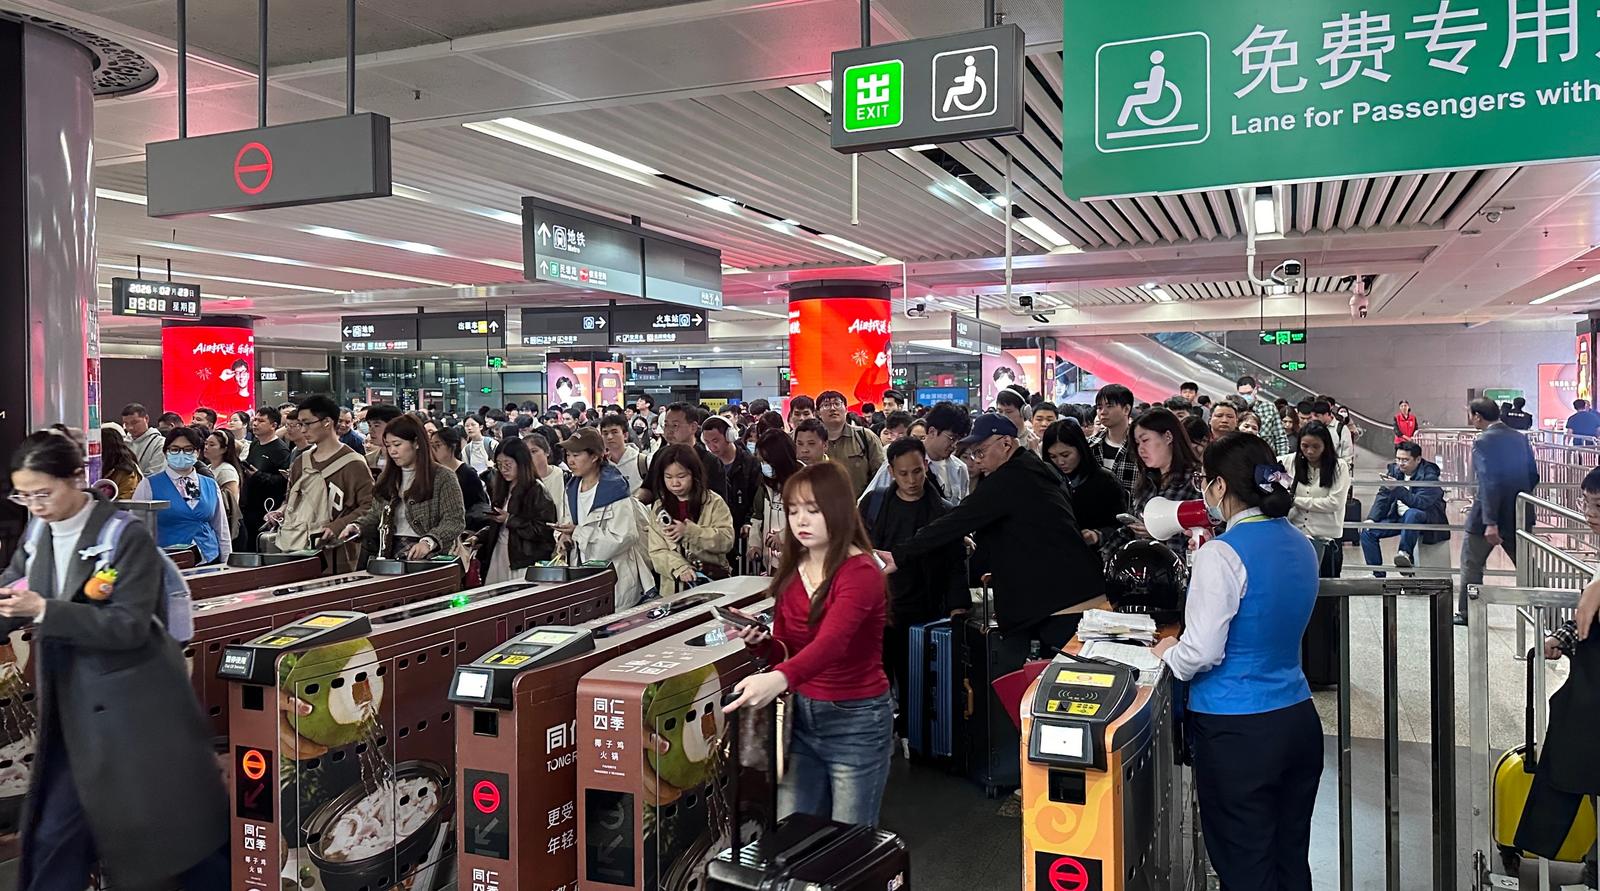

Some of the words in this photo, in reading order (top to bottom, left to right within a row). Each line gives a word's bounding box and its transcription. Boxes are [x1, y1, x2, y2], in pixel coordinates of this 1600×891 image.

[1232, 0, 1600, 98] 免费专用
[857, 73, 890, 106] 出
[856, 104, 889, 121] EXIT
[1231, 112, 1296, 135] Lane
[1303, 106, 1343, 128] for
[1352, 87, 1526, 123] Passengers
[1536, 79, 1600, 106] with
[567, 229, 586, 247] 地铁
[656, 314, 679, 323] 火车站
[329, 481, 345, 520] P
[594, 698, 625, 715] 同仁
[594, 715, 625, 732] 四季
[600, 751, 620, 762] 火锅
[547, 800, 574, 830] 更受
[244, 824, 267, 839] 同仁
[244, 837, 267, 851] 四季
[547, 829, 578, 855] 年轻
[473, 868, 499, 885] 同仁
